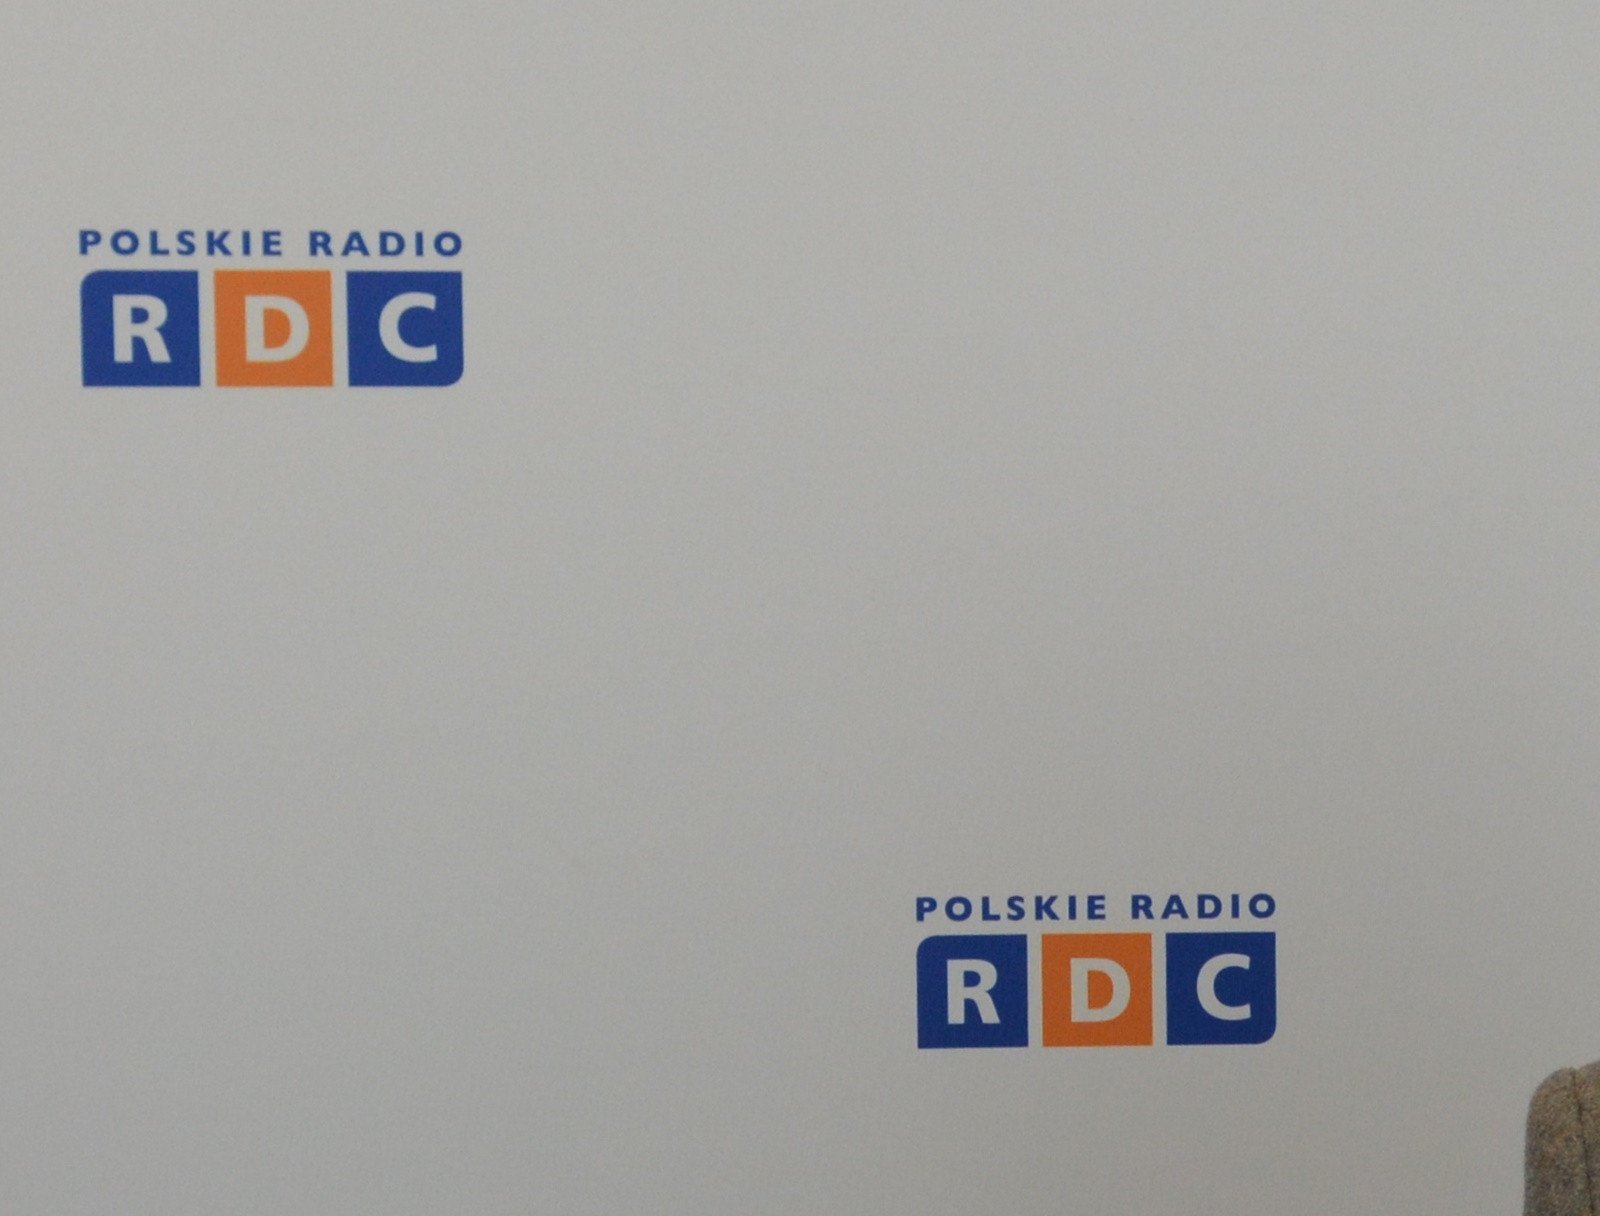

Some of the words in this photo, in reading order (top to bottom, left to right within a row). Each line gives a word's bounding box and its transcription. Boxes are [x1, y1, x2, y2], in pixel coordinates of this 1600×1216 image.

[78, 229, 281, 257] POLSKIE
[308, 230, 463, 258] RADIO
[114, 293, 436, 363] RDC
[915, 894, 1105, 923] POLSKIE
[1131, 893, 1276, 920] RADIO
[947, 953, 1251, 1025] RDC
